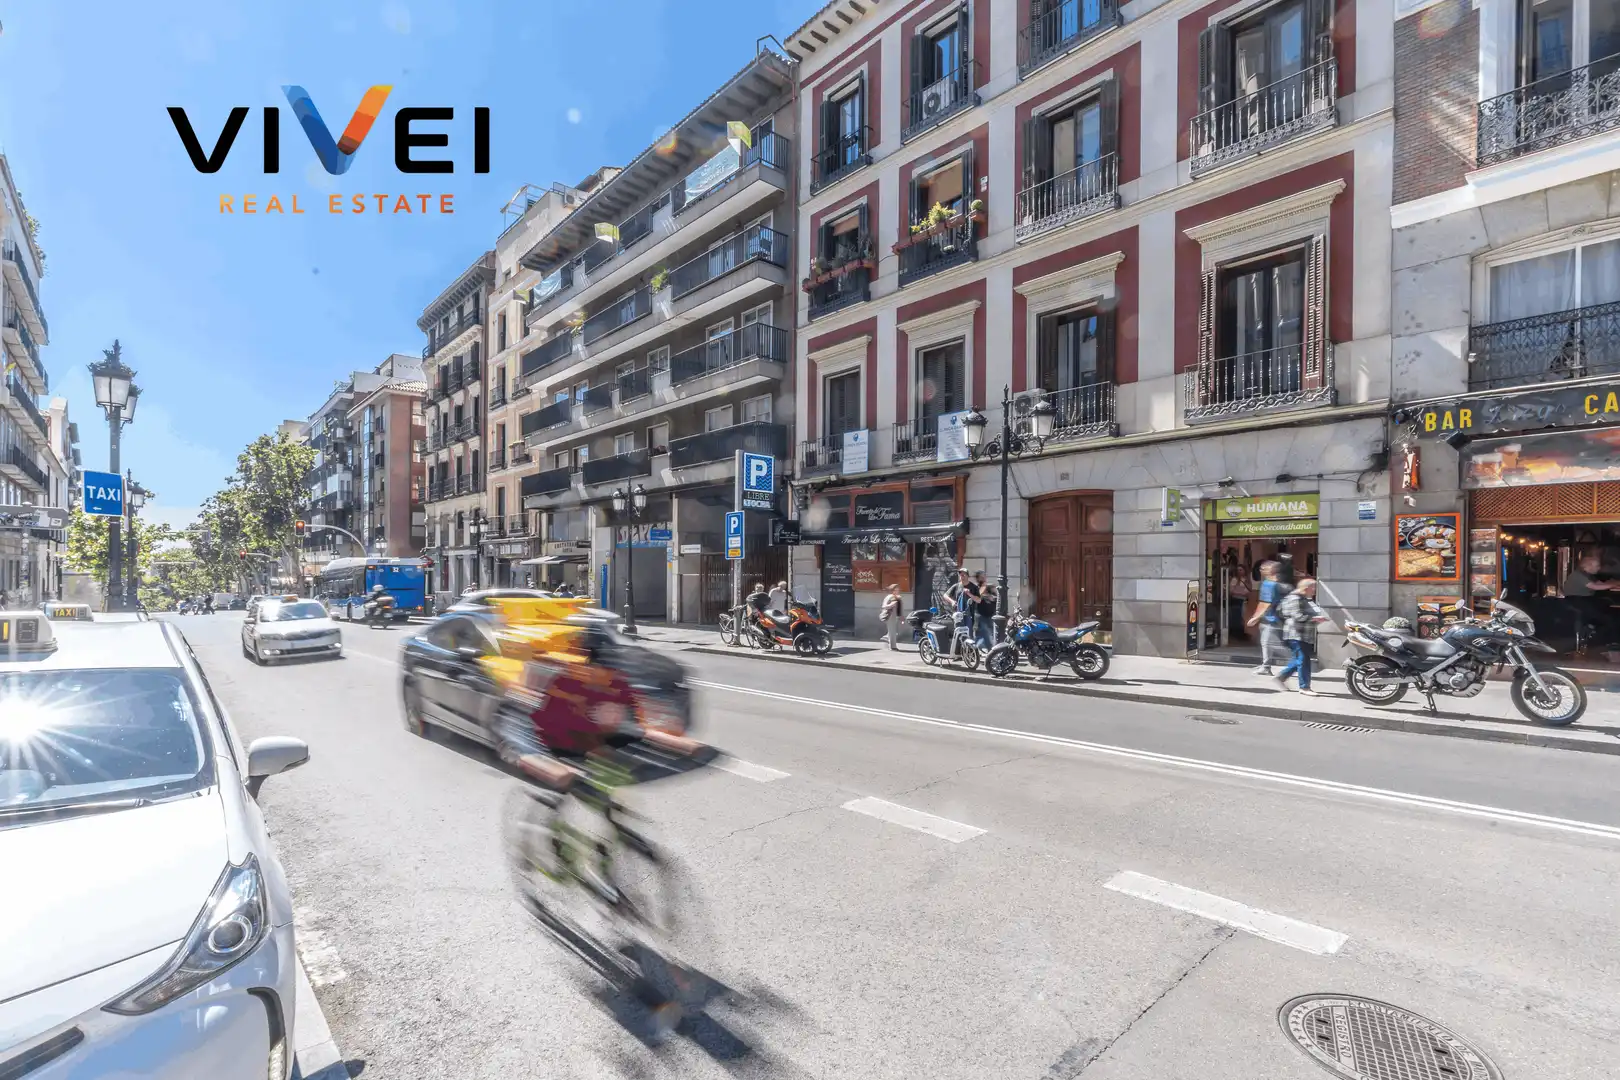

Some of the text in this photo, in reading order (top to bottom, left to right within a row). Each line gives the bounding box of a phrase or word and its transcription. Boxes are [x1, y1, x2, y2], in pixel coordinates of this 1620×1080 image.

[1425, 408, 1472, 432] BAR
[751, 459, 767, 486] P
[86, 486, 121, 502] TAXI
[747, 492, 770, 500] LIBRE
[1246, 500, 1308, 513] HUMANA
[730, 517, 738, 533] P
[55, 608, 76, 617] TAXI
[1335, 1013, 1351, 1058] REGISTRO
